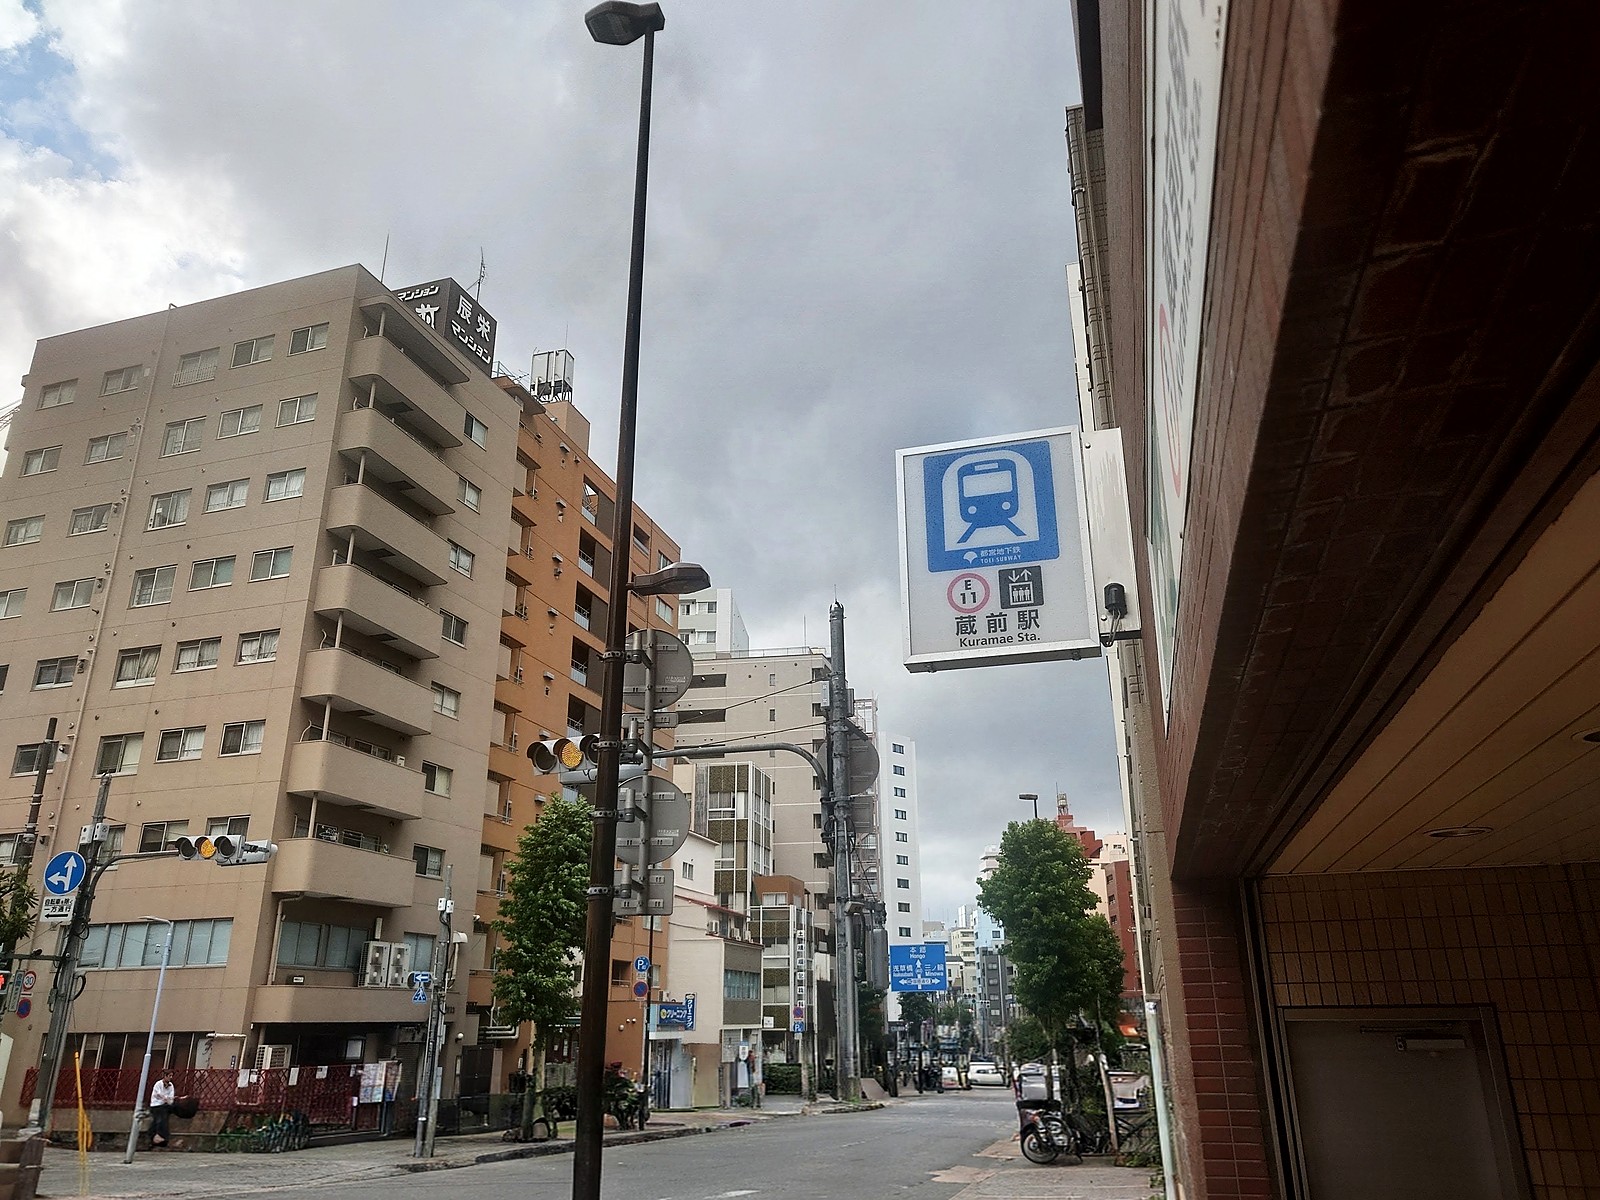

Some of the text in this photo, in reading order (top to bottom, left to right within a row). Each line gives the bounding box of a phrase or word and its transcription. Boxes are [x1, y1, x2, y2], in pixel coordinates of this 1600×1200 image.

[397, 285, 439, 302] マンション
[456, 294, 491, 342] 辰栄
[451, 319, 491, 364] マンション
[980, 546, 1021, 557] 都営地下鉄
[964, 579, 972, 590] E
[960, 591, 977, 604] 11
[954, 609, 1040, 636] 蔵前駅
[959, 632, 1041, 648] Kuramae Sta.
[24, 975, 33, 985] 30
